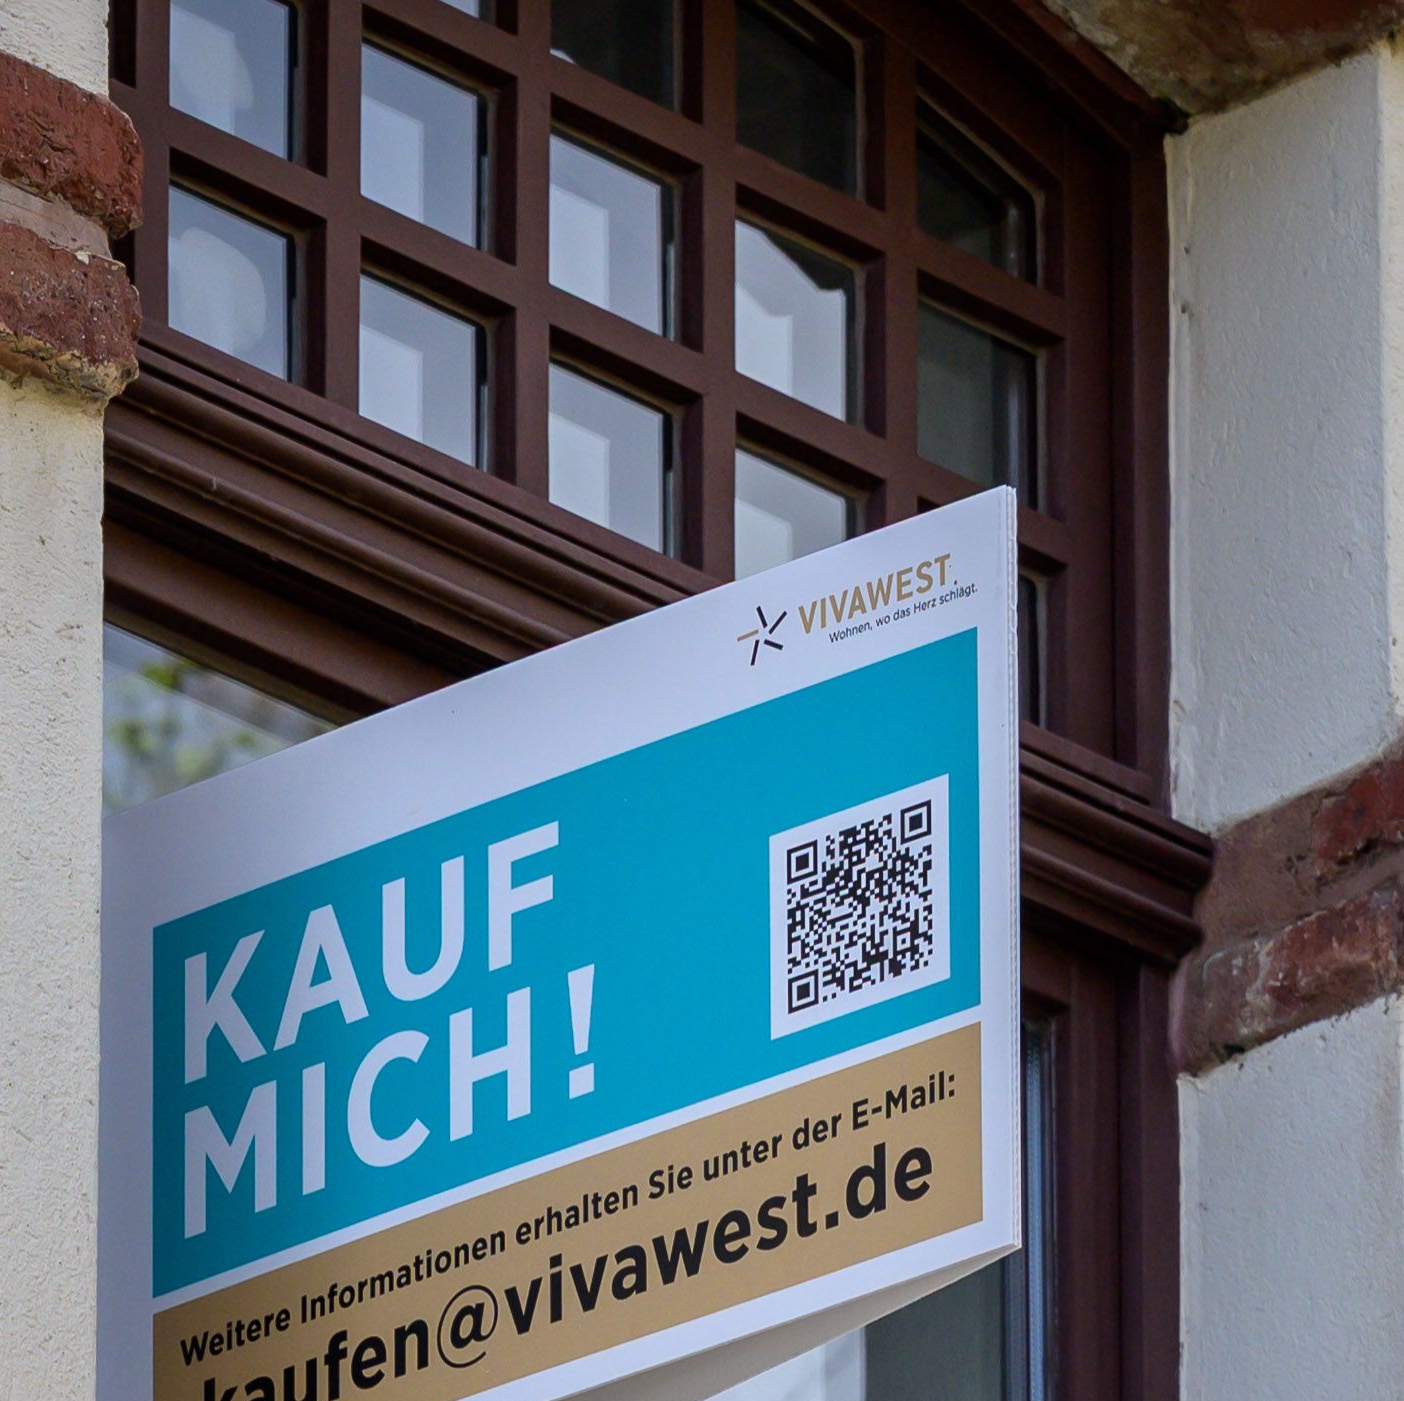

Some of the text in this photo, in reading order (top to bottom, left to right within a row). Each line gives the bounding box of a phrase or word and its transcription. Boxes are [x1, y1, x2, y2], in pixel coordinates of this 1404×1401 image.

[828, 583, 978, 643] Wohnen, wo das Herz schlägt.
[182, 821, 560, 1084] KAUF
[180, 1070, 957, 1367] Weitere Informationen erhalten Sie unter der E-Mail:
[182, 964, 596, 1238] MICH!
